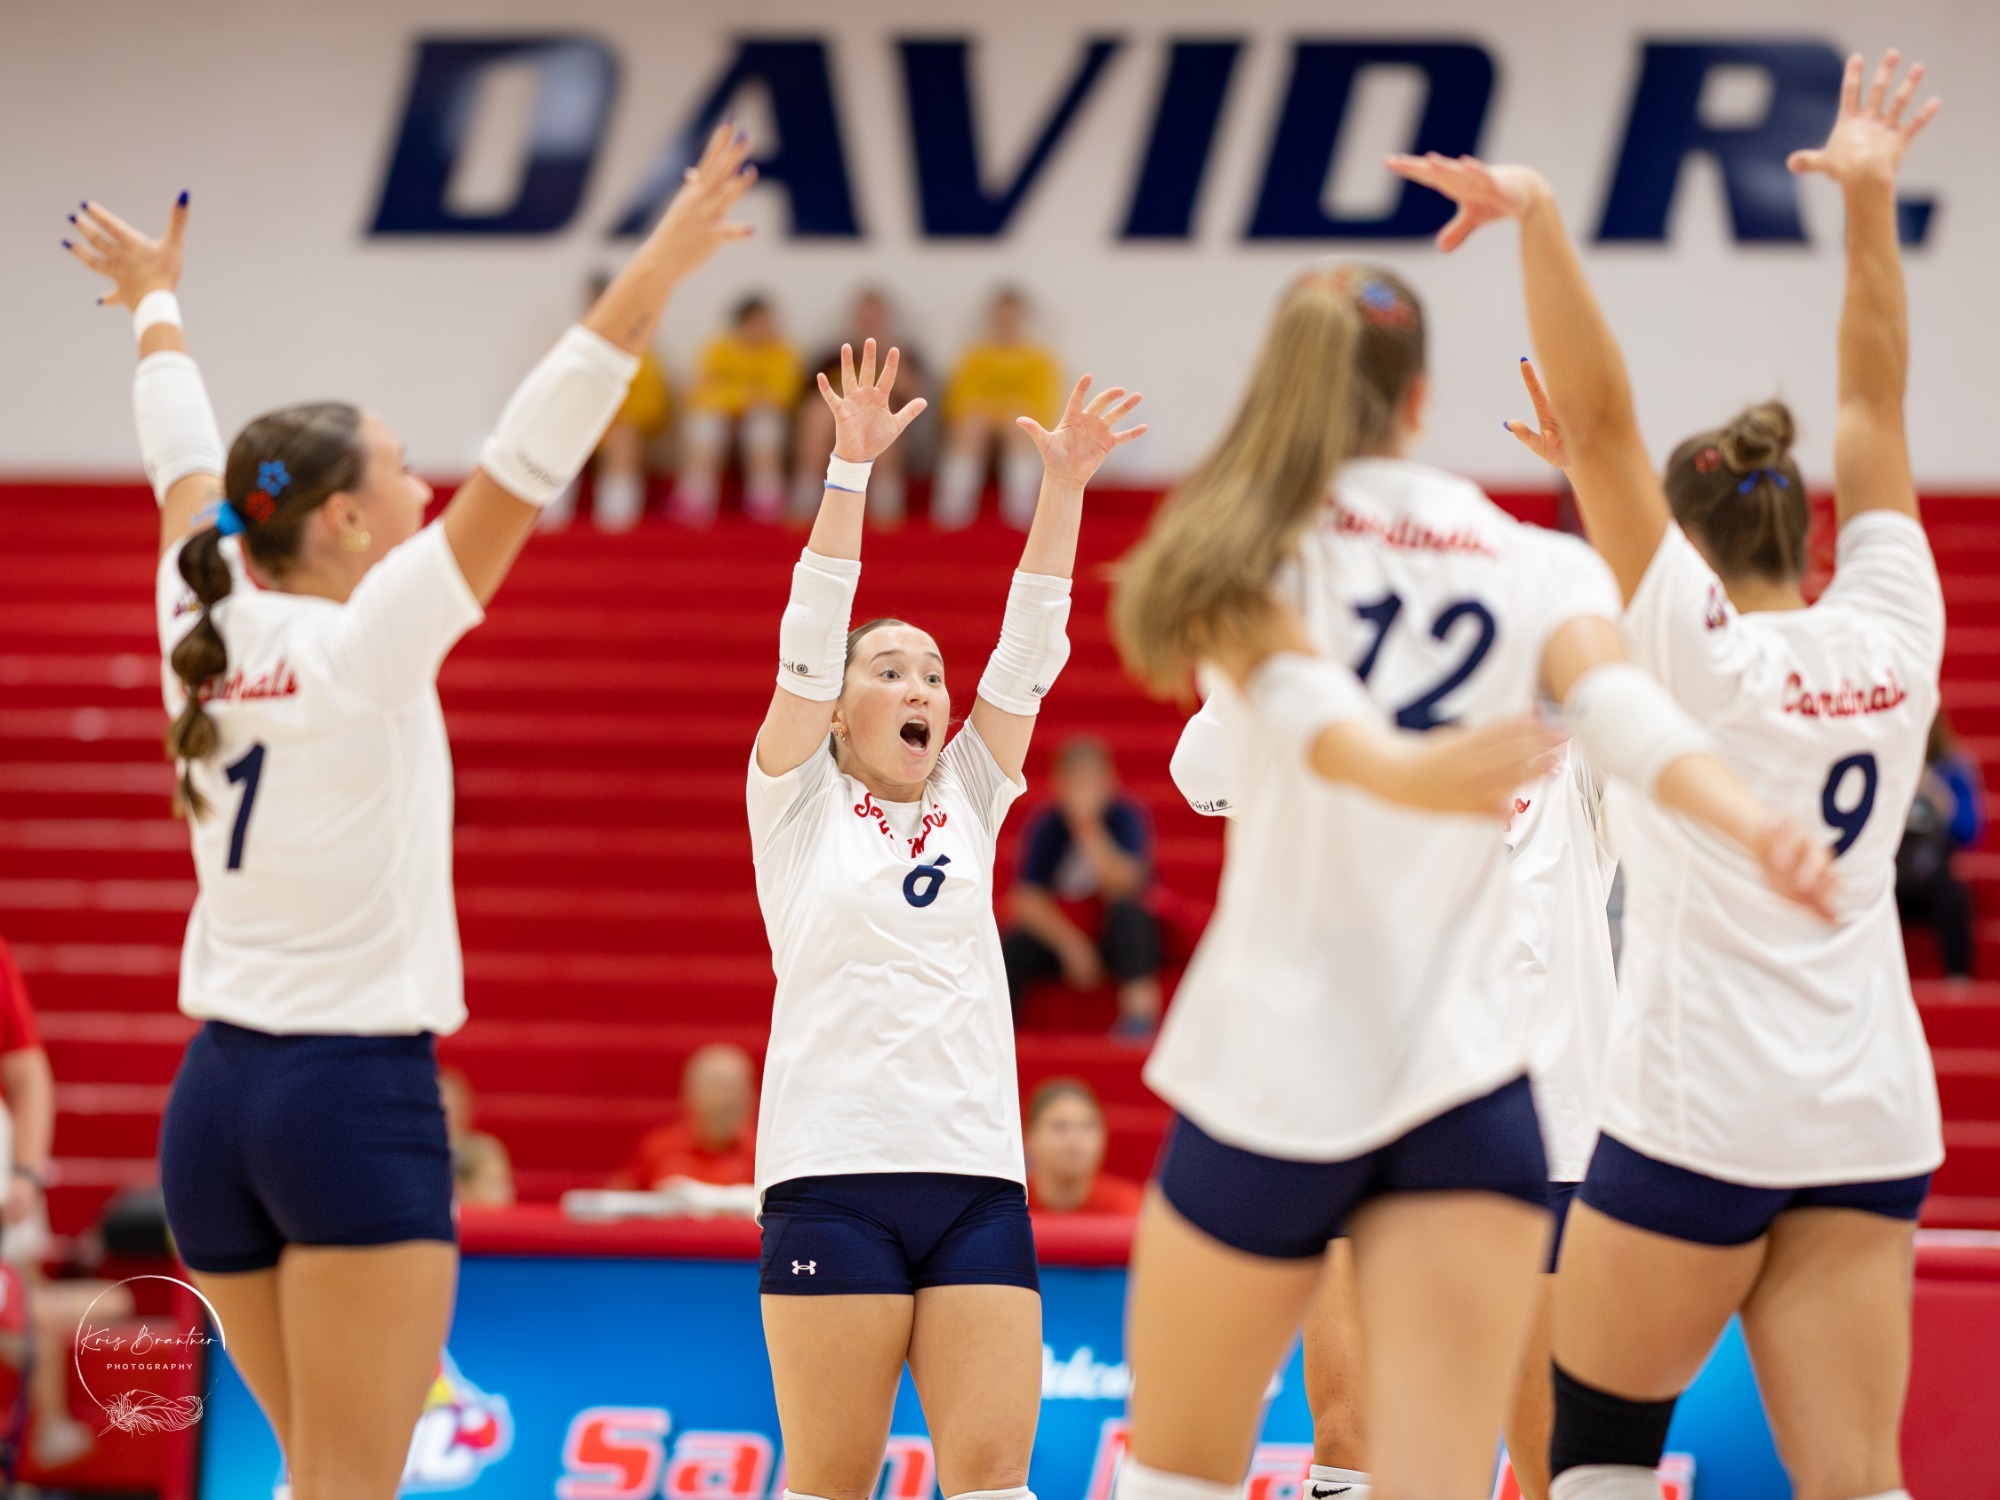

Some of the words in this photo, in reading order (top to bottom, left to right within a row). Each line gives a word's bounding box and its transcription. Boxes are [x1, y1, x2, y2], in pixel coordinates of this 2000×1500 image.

[364, 36, 1502, 241] DAVID
[1588, 36, 1938, 245] R.
[1353, 589, 1497, 732] 12
[225, 738, 267, 870] 1
[1821, 752, 1878, 858] 9
[903, 853, 952, 908] 6
